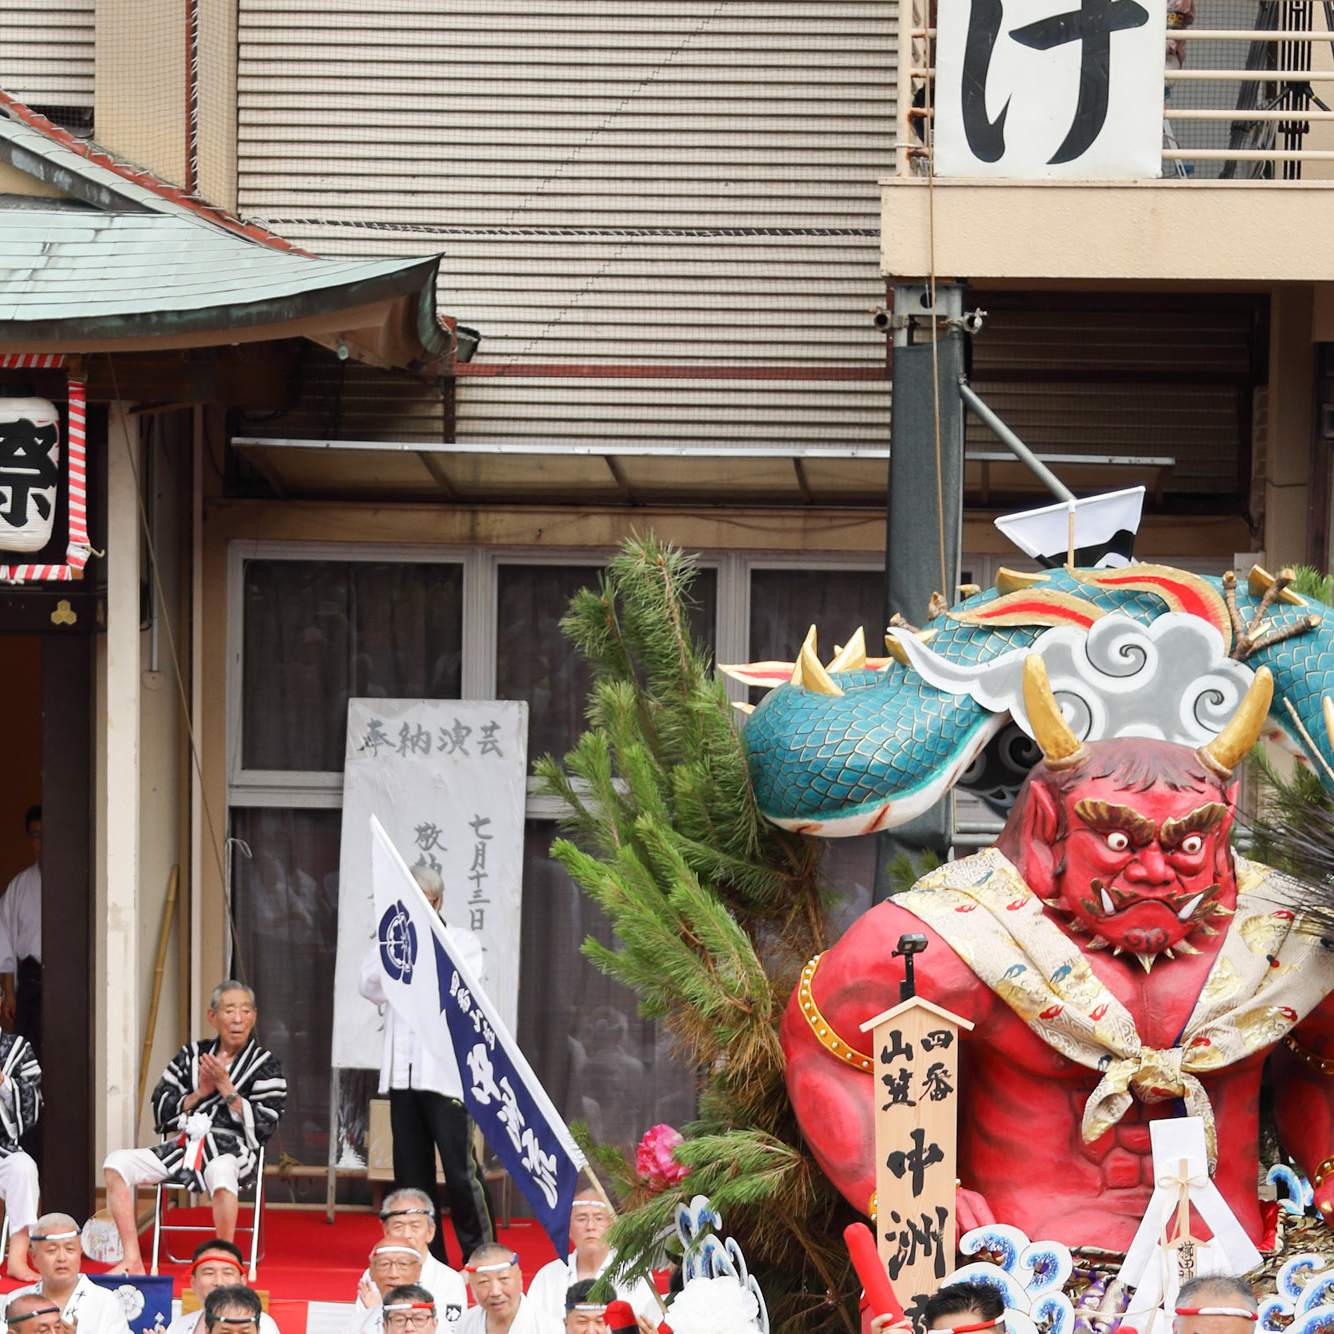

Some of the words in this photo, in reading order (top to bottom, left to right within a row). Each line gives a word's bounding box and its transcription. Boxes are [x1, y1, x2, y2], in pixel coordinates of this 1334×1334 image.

[961, 0, 1150, 165] け
[358, 717, 505, 759] 奉納演芸
[467, 813, 494, 932] 七月十三日
[880, 1028, 917, 1111] 山笠
[919, 1028, 955, 1102] 四番
